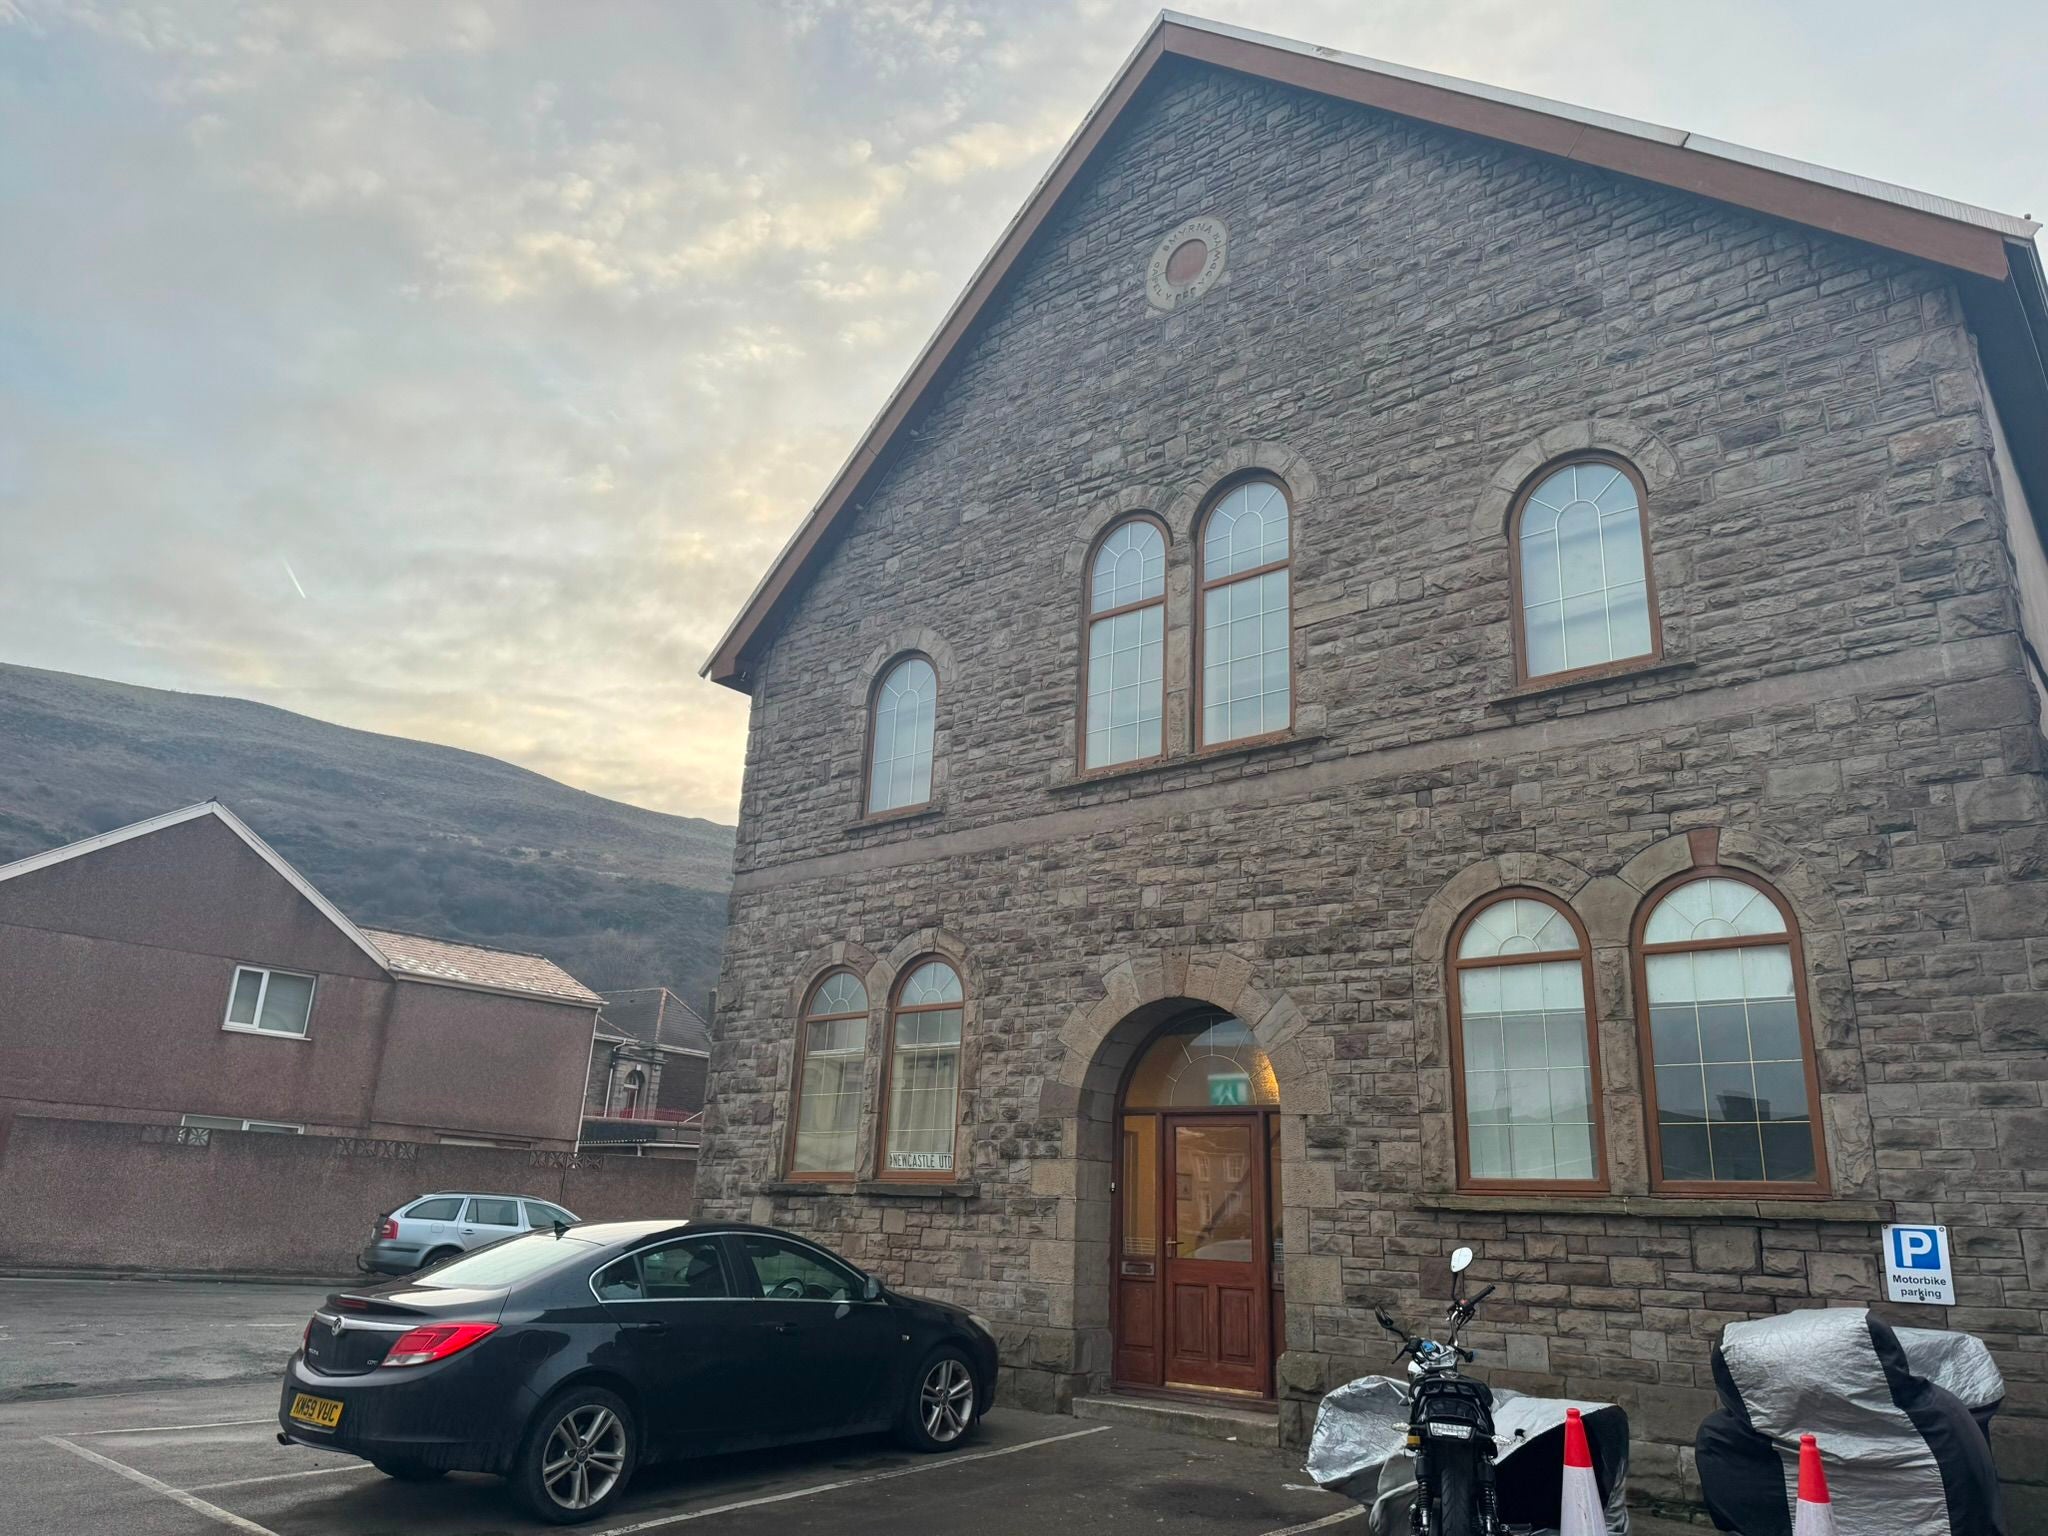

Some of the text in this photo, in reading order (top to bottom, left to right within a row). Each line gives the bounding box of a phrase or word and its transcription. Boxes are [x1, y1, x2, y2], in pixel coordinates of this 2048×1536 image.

[892, 1153, 952, 1169] NEWCASTLE UTD
[1900, 1230, 1932, 1267] P
[1892, 1274, 1947, 1286] Motorbike
[1901, 1288, 1942, 1300] parking
